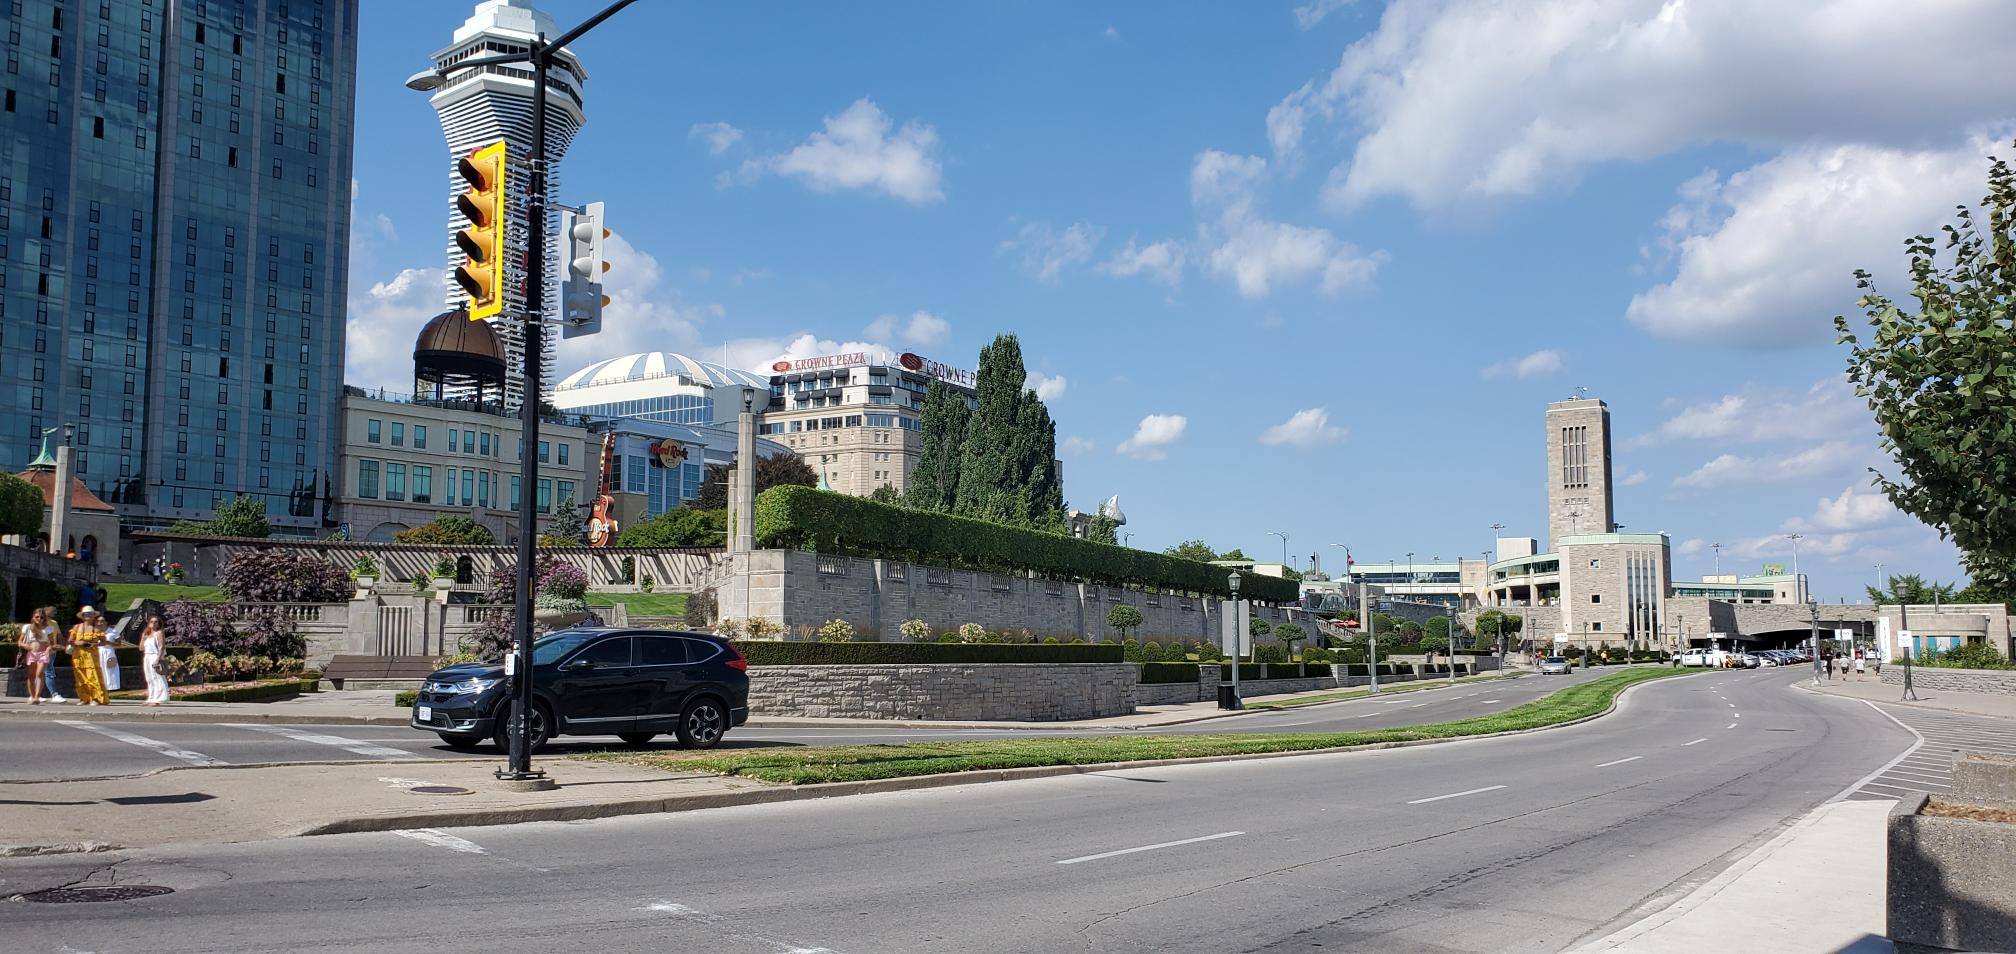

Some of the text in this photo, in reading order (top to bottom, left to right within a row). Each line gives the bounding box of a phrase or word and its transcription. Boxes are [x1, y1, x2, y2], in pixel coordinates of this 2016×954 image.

[795, 352, 866, 370] CROWNE PLAZA
[926, 360, 967, 384] CROWNE
